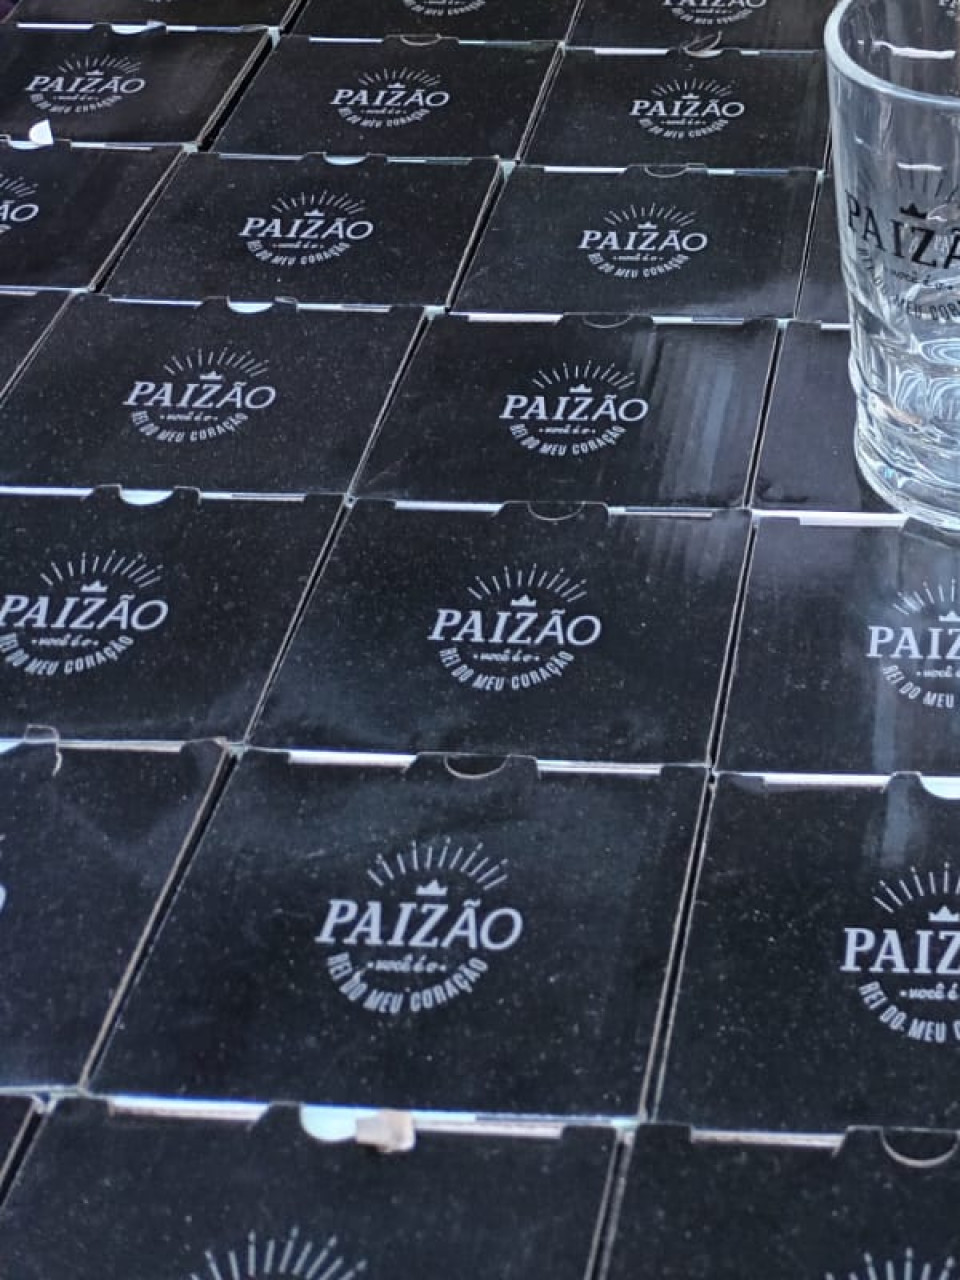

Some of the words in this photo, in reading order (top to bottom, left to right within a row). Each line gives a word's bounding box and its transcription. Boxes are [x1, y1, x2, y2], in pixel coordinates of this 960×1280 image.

[25, 76, 146, 94] PAIZÃO
[329, 89, 450, 107] PAIZÃO
[629, 99, 745, 118] PAIZÃO
[238, 217, 374, 240] PAIZÃO
[577, 229, 708, 252] PAIZÃO
[122, 381, 276, 410] PAIZÃO
[499, 394, 649, 422] PAIZÃO
[0, 593, 169, 631] PAIZÃO
[427, 608, 602, 646] PAIZÃO
[315, 899, 523, 951] PAIZÃO
[328, 952, 352, 982] REI
[339, 971, 368, 1001] DO
[410, 958, 488, 1012] CORAÇÃO
[363, 990, 404, 1013] MEU
[860, 981, 888, 1011] REI
[880, 1005, 907, 1031] DO
[908, 1019, 947, 1043] MEU
